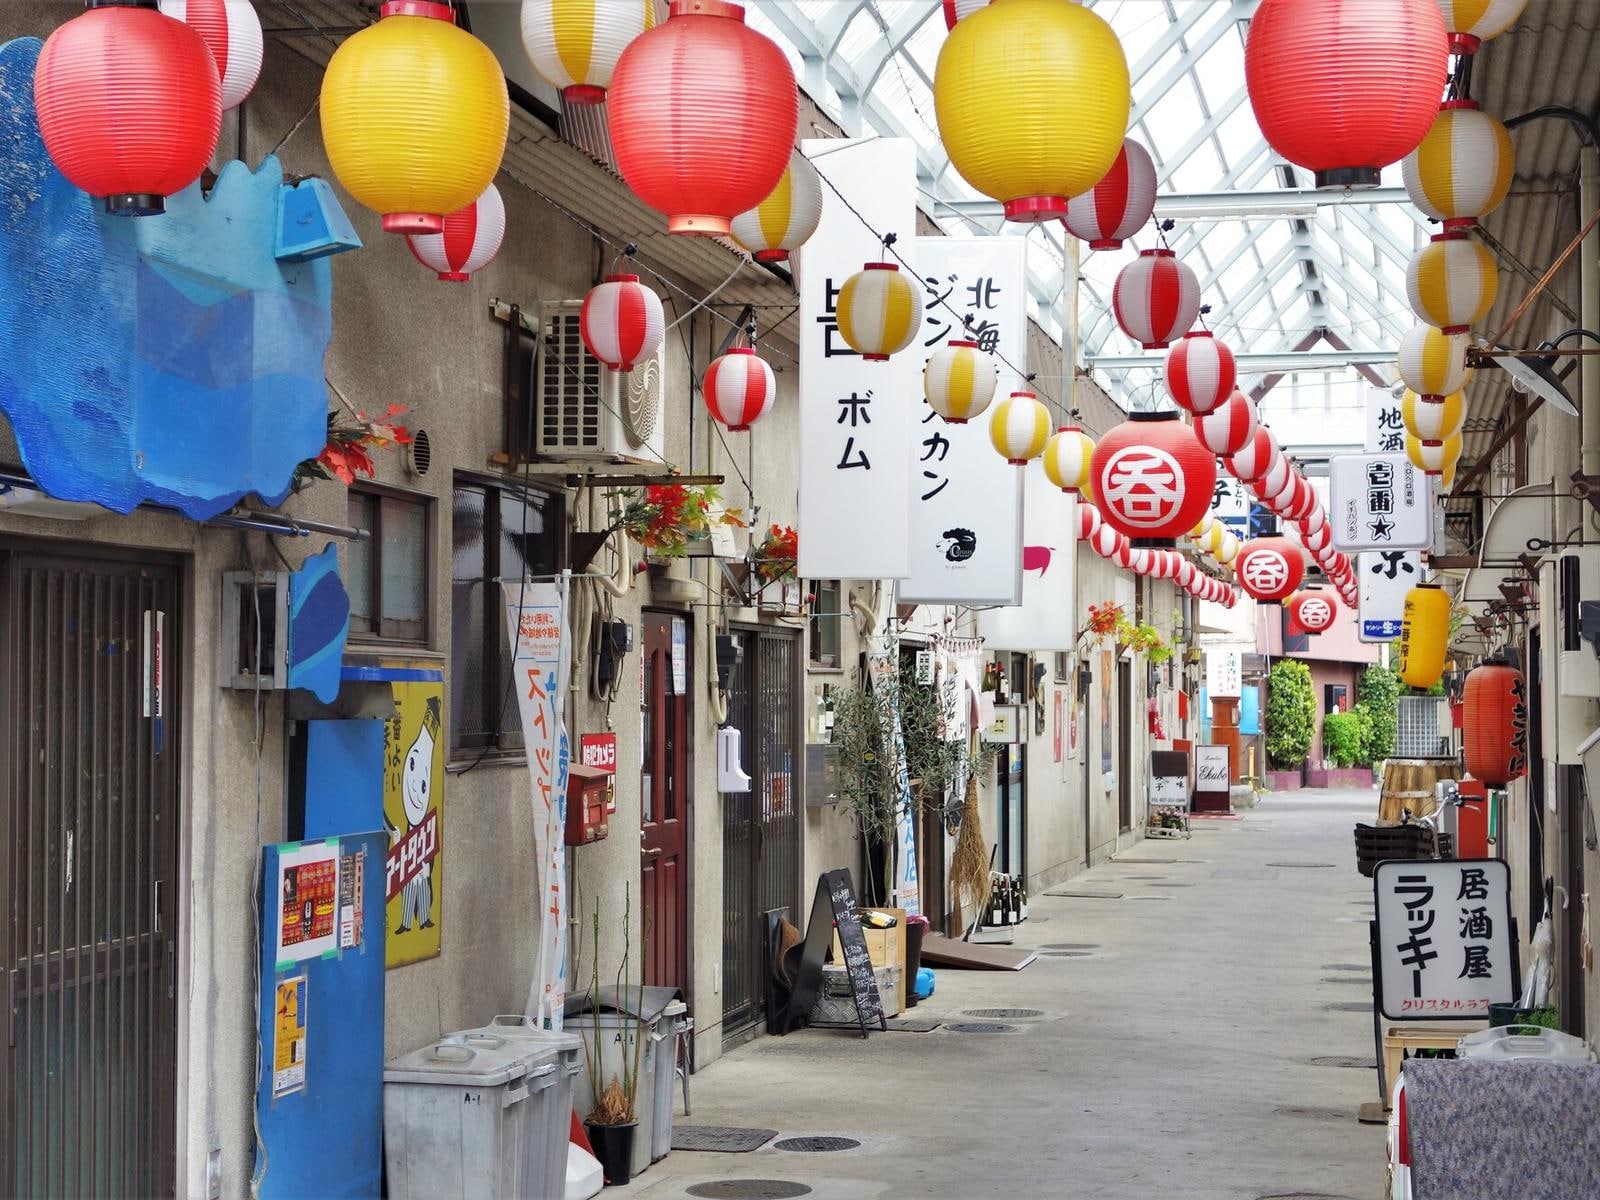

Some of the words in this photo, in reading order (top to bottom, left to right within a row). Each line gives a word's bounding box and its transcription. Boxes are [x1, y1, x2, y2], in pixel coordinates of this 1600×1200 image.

[966, 276, 1002, 374] 北海
[920, 273, 959, 501] ジンカン
[1110, 458, 1174, 518] 呑
[1246, 554, 1286, 590] 呑
[1301, 600, 1329, 626] 呑
[1199, 766, 1227, 781] Ekubo
[1394, 875, 1439, 998] ラッキー
[1456, 868, 1493, 980] 居酒屋
